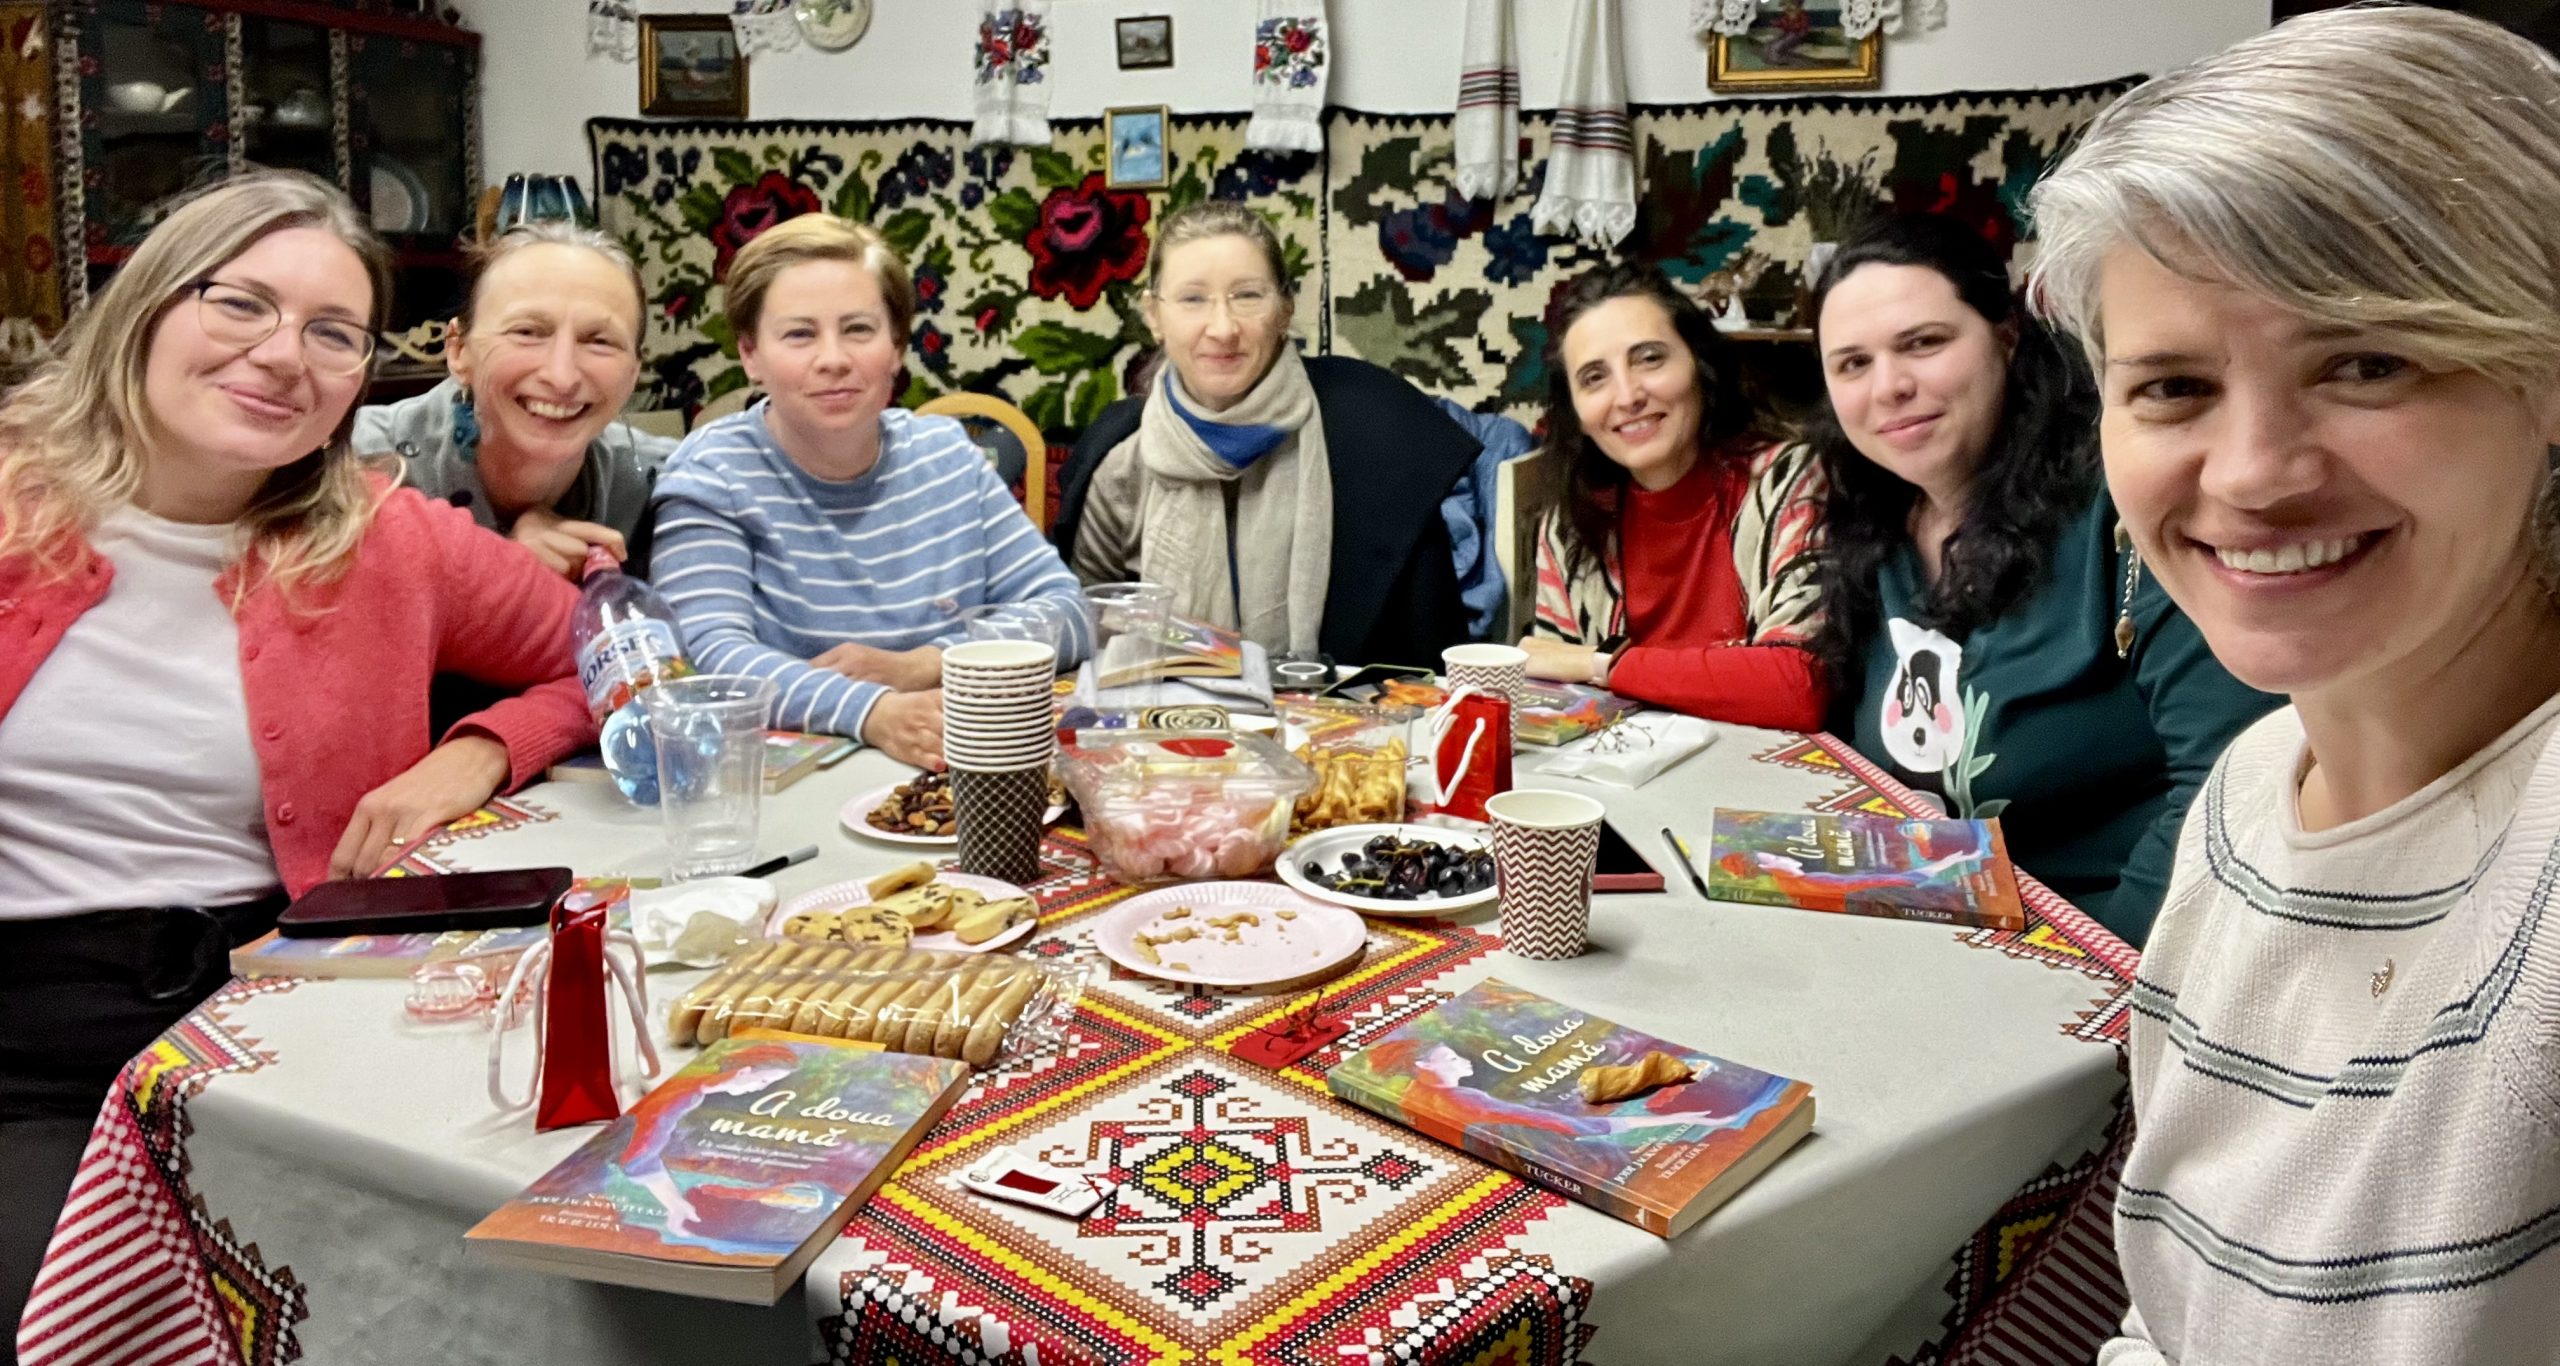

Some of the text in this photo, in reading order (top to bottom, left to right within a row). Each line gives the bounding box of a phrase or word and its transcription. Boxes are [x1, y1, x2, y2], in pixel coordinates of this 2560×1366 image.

[1902, 907, 1953, 920] TUCKER
[1482, 1018, 1584, 1073] A doua
[1520, 1039, 1607, 1093] mamă
[749, 1090, 896, 1127] A doua
[709, 1117, 848, 1147] mamă
[1524, 1163, 1582, 1195] TUCKER
